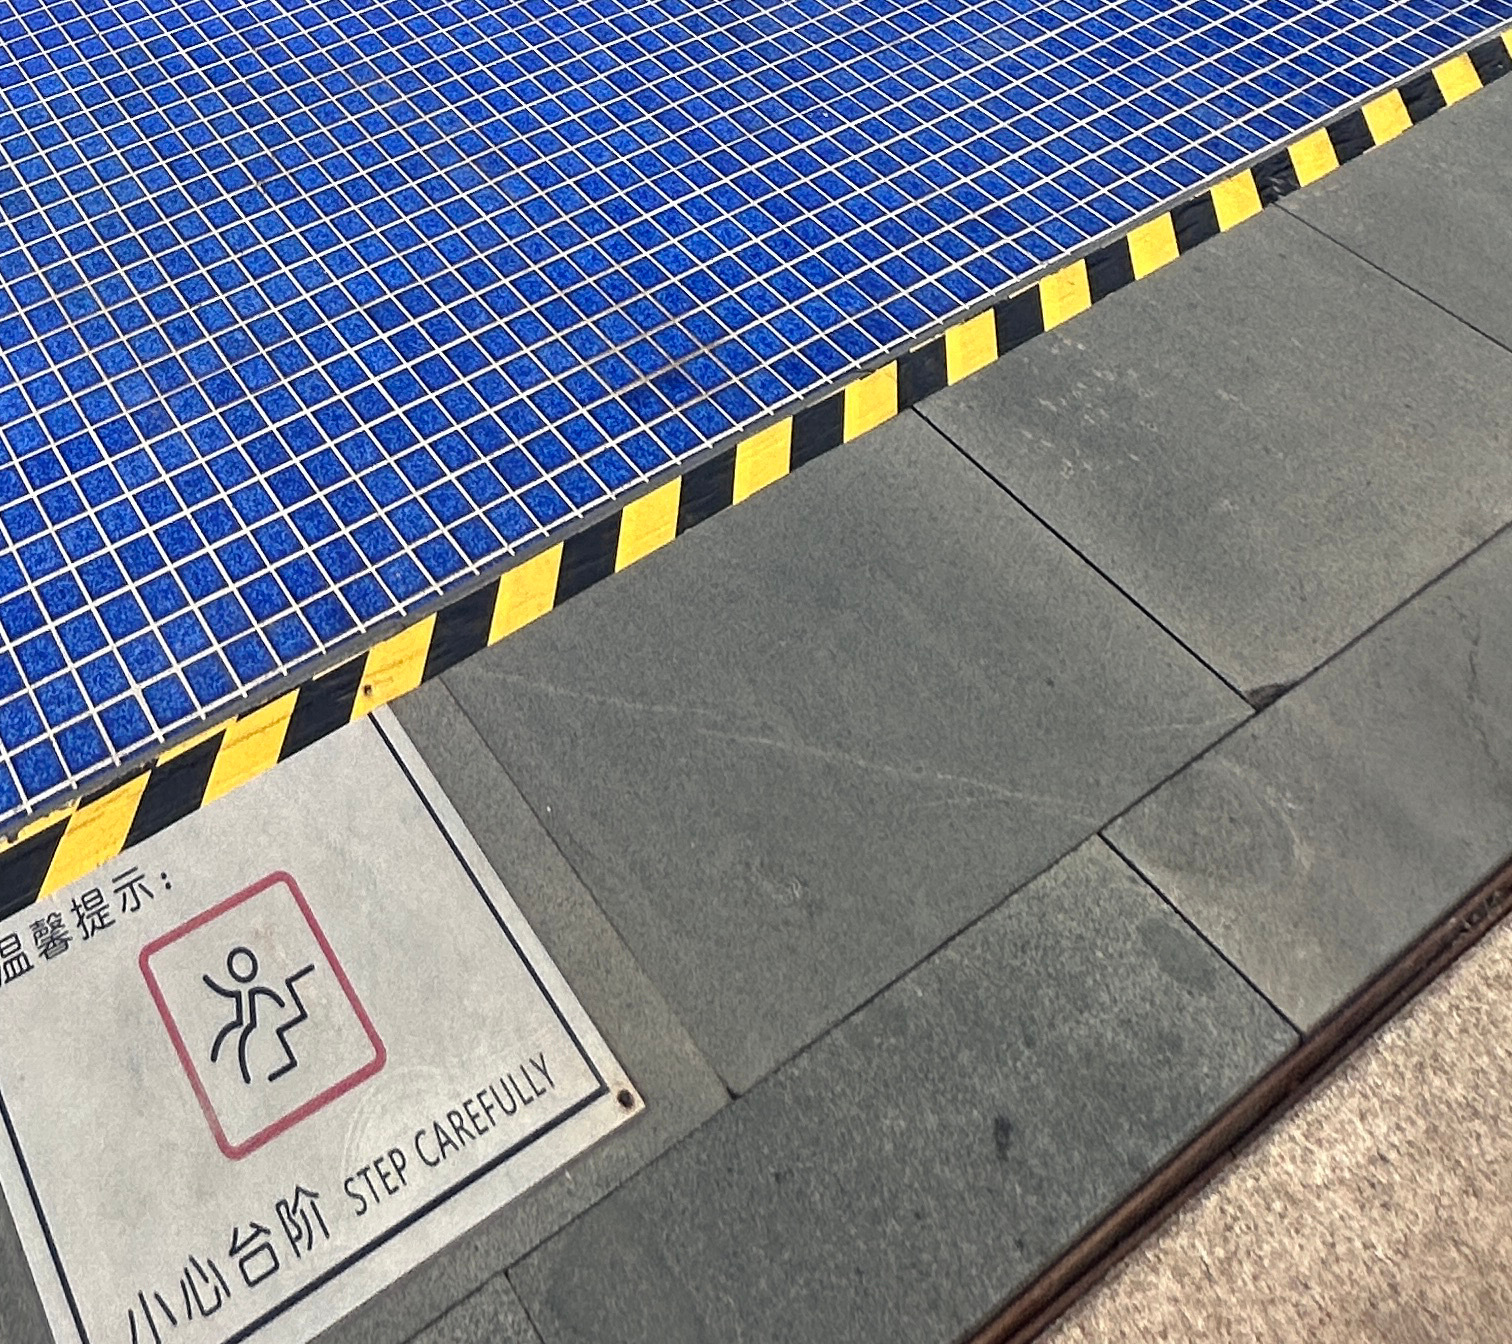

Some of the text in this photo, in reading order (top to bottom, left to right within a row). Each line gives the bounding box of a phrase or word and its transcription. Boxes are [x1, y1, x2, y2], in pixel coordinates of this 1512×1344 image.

[128, 1051, 555, 1344] 小心台阶 STEP CAREFULLY
